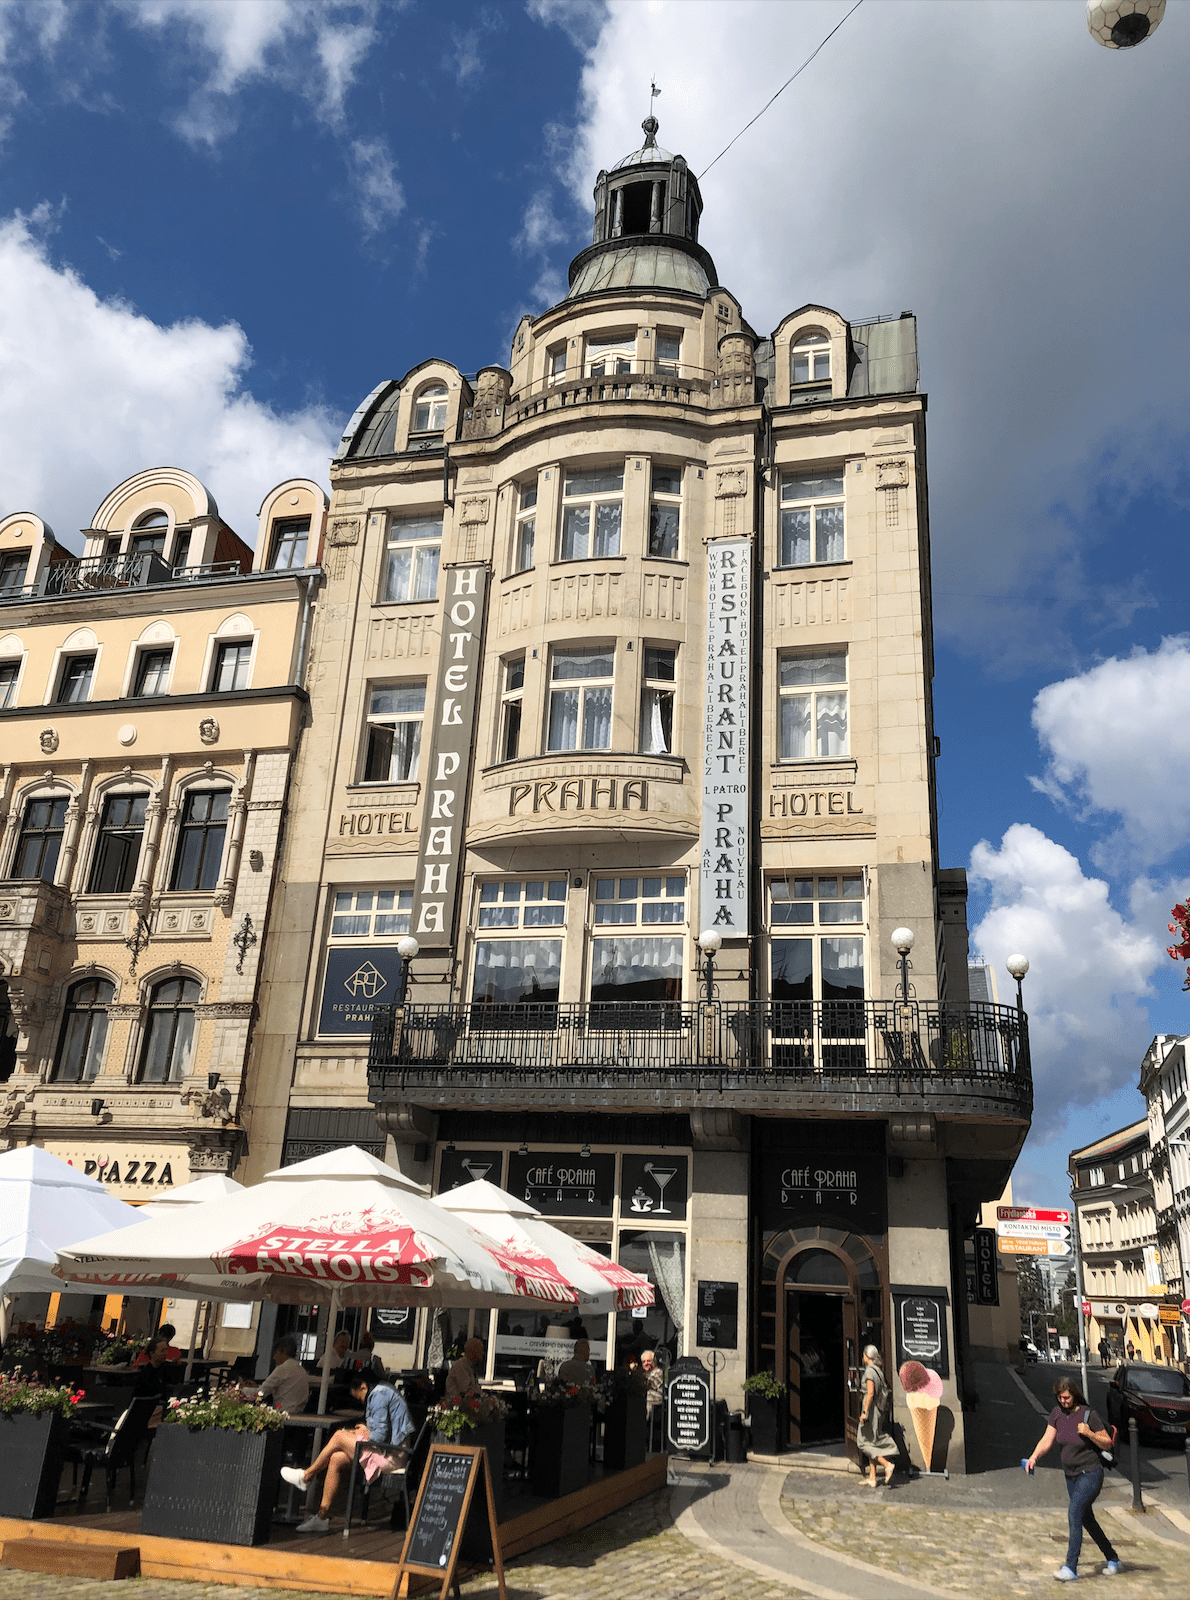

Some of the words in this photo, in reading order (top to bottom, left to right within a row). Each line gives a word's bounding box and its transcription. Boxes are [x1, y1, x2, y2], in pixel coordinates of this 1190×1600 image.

[441, 568, 479, 726] HOTEL
[716, 550, 737, 773] RESTAURANT
[509, 778, 649, 817] PRAHA
[713, 784, 746, 794] PATRO
[769, 791, 863, 817] HOTEL
[339, 811, 419, 836] HOTEL
[416, 752, 461, 933] PRAHA
[703, 849, 711, 879] ART
[737, 826, 745, 900] NOUVEAU
[712, 803, 735, 926] PRAHA
[557, 1168, 596, 1186] PRAHA
[781, 1166, 810, 1188] CAFÉ
[814, 1169, 857, 1188] PRAHA
[258, 1236, 401, 1254] STELLA
[1001, 1243, 1046, 1252] RESTAURANT
[256, 1251, 400, 1282] ARTOIS
[980, 1235, 992, 1298] HOTEL
[525, 1277, 576, 1303] ARTOIS
